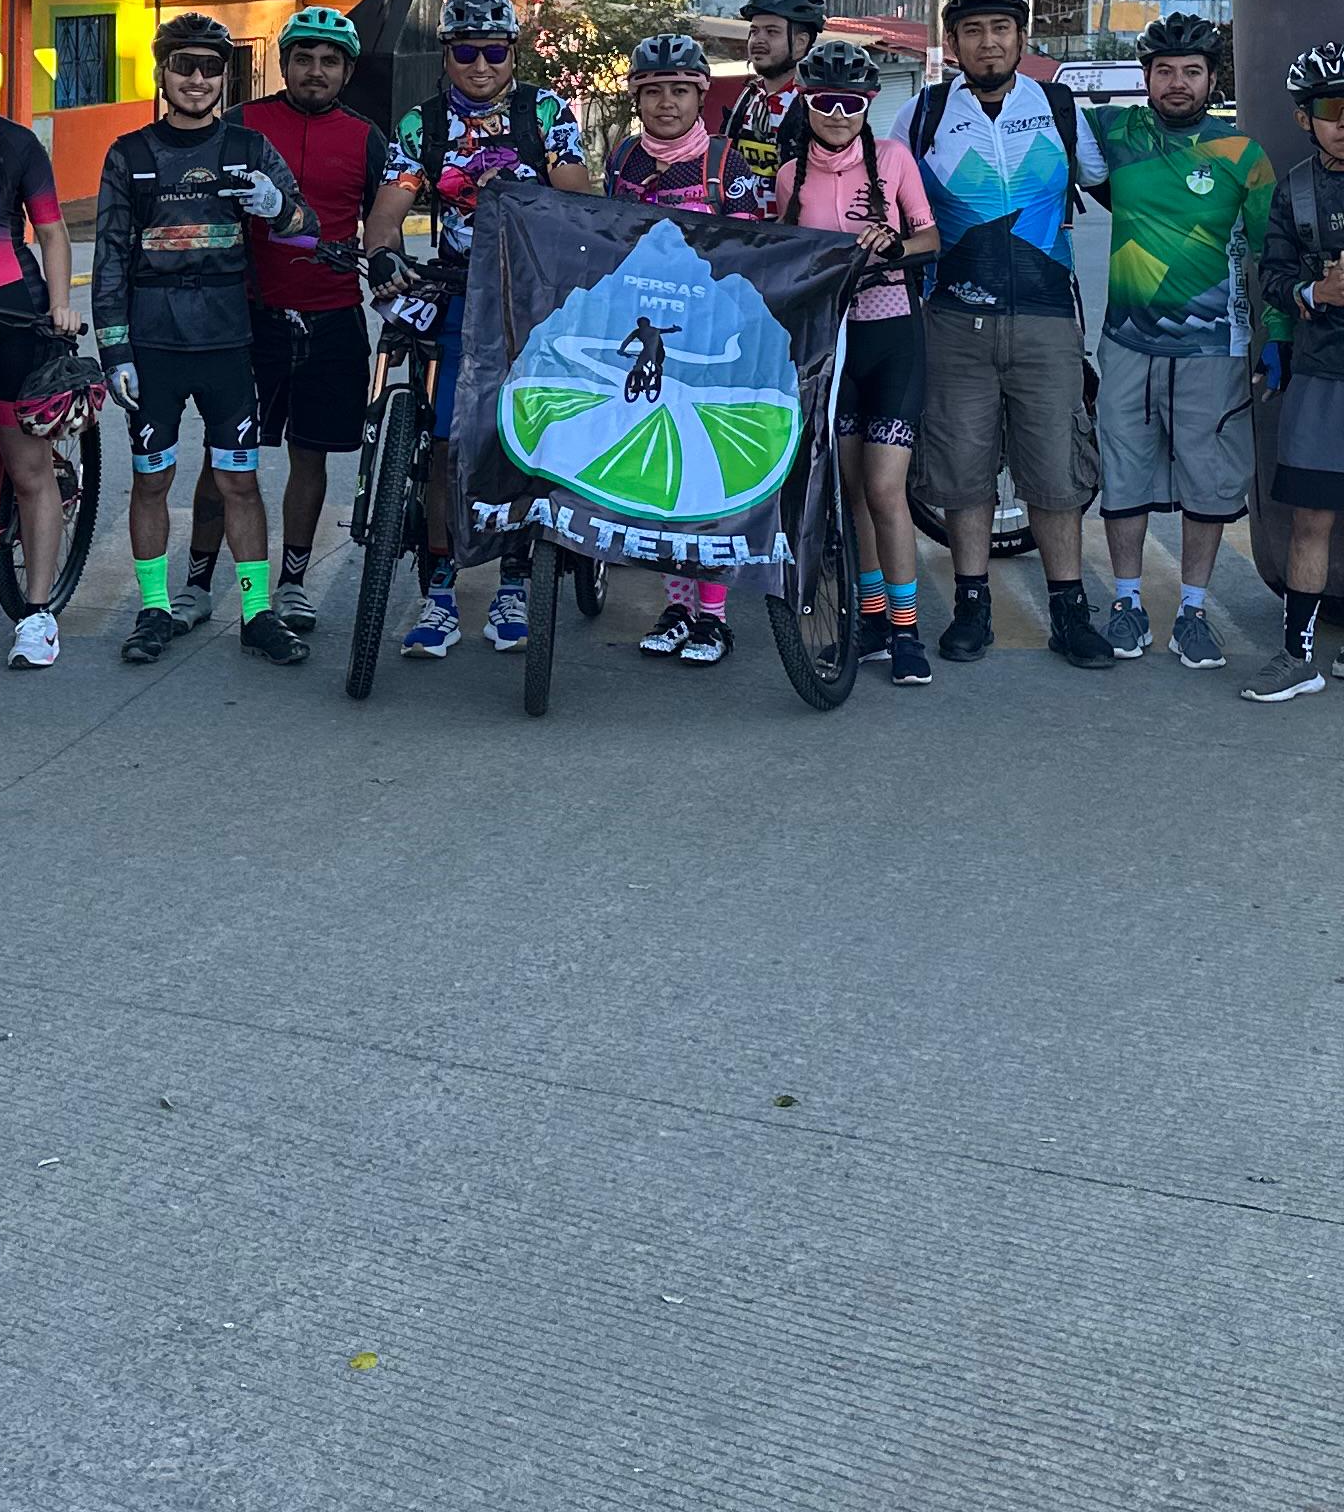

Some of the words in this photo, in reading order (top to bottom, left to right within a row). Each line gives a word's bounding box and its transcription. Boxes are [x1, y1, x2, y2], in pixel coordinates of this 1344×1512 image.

[623, 274, 706, 298] PERSAS
[390, 293, 438, 332] 129
[640, 295, 685, 313] MTB
[472, 498, 796, 567] TLALTETELA
